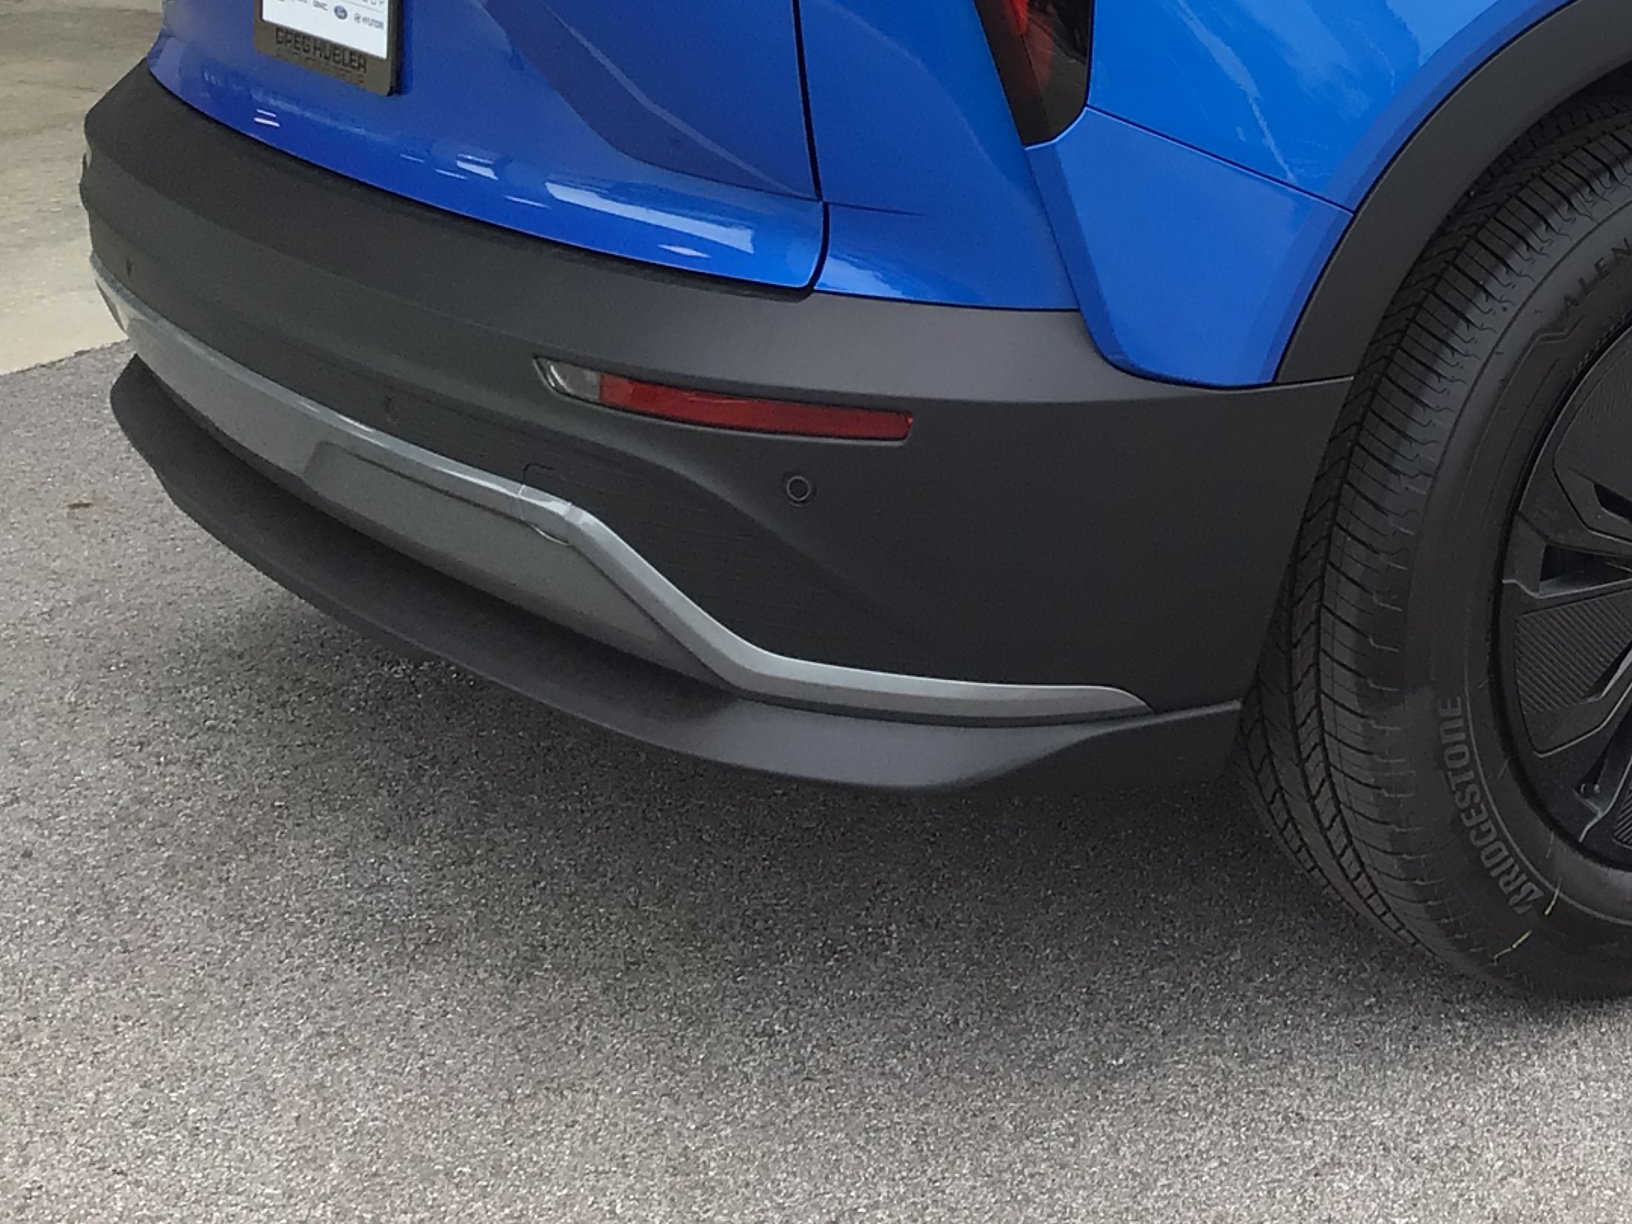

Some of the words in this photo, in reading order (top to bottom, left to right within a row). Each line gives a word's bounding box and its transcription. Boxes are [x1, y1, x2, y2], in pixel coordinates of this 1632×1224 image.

[275, 26, 312, 54] GREG
[313, 38, 366, 73] HUBLER
[1439, 695, 1545, 915] BRIDGESTONE
